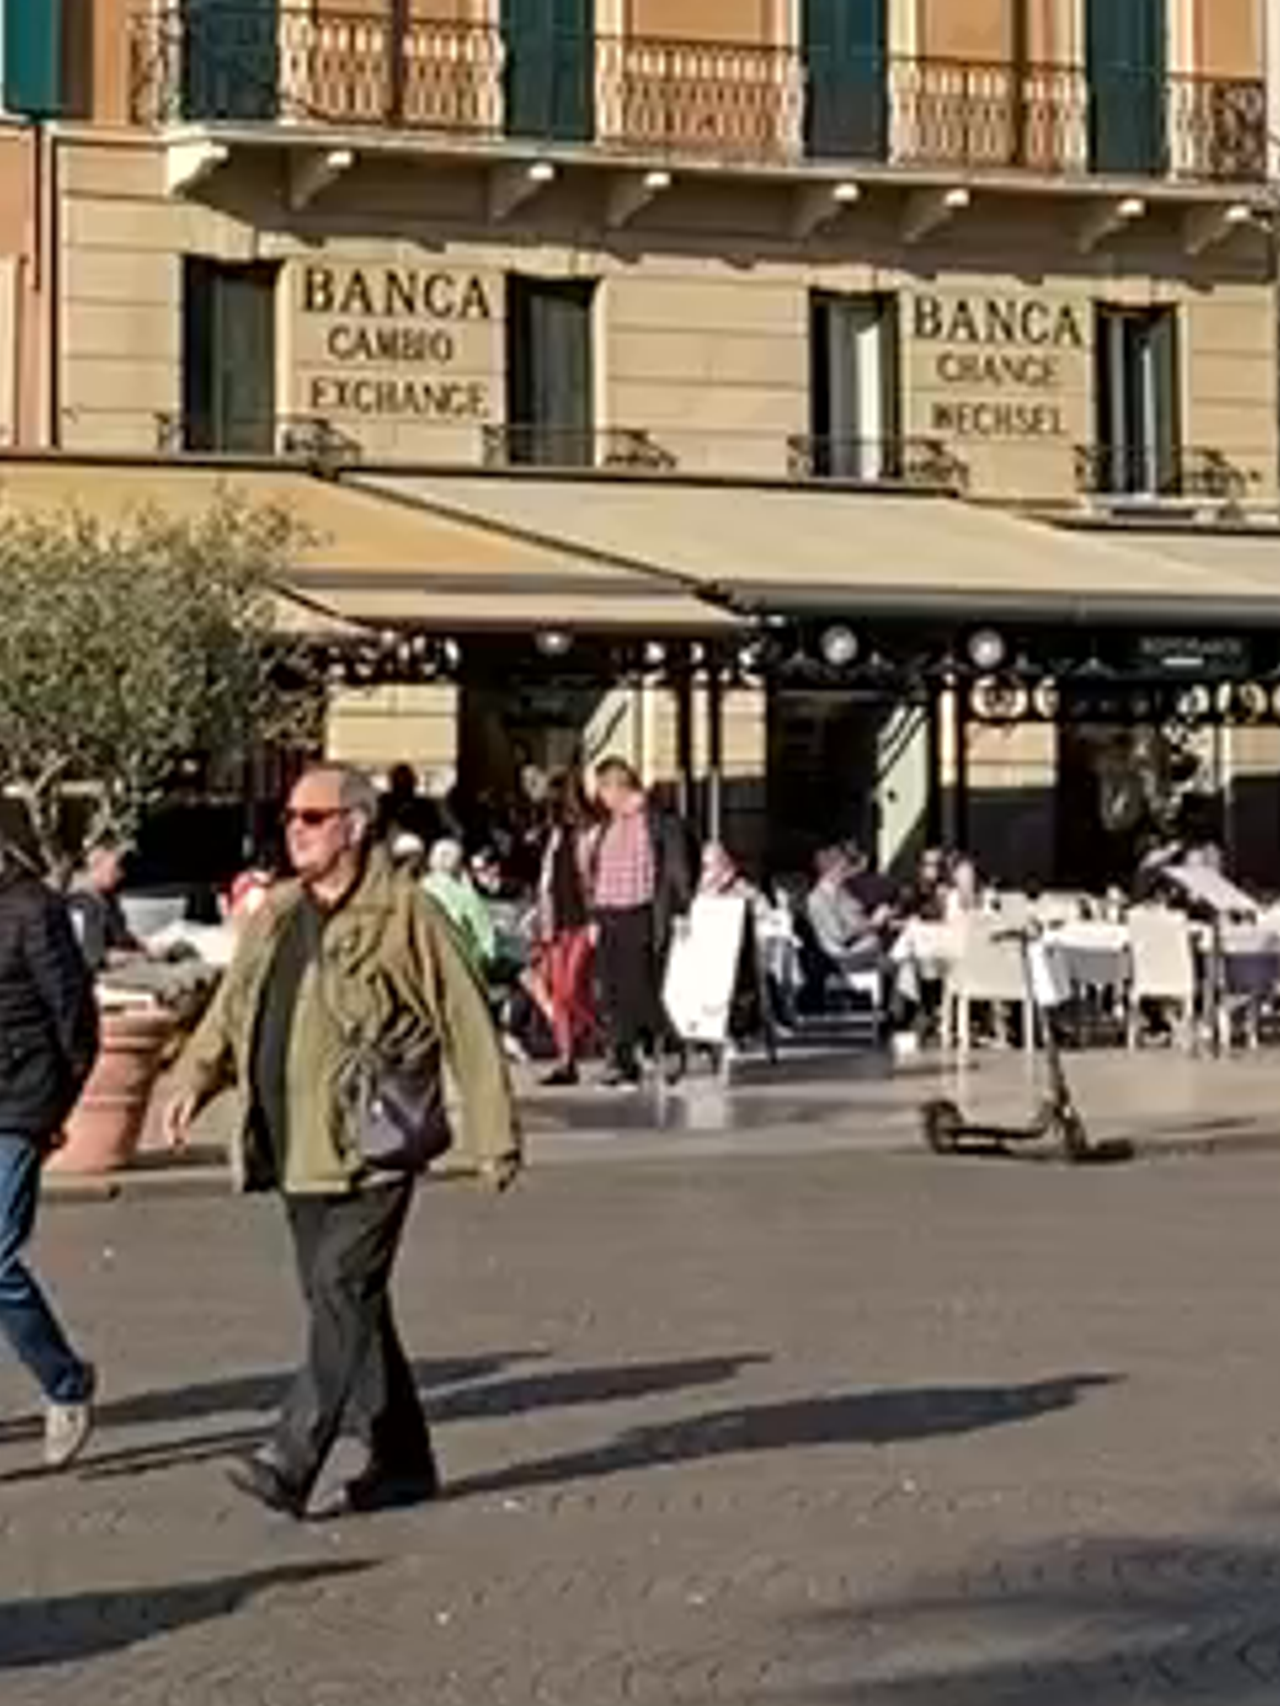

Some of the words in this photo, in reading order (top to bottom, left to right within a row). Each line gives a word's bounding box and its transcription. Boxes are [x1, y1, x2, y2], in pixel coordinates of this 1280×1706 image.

[303, 267, 489, 317] BANCA
[916, 296, 1082, 345] BANCA
[328, 324, 452, 362] CAMBIO
[937, 352, 1056, 386] CHANGE
[312, 379, 488, 416] EXCHANGE
[933, 403, 1068, 434] WECHSEL
